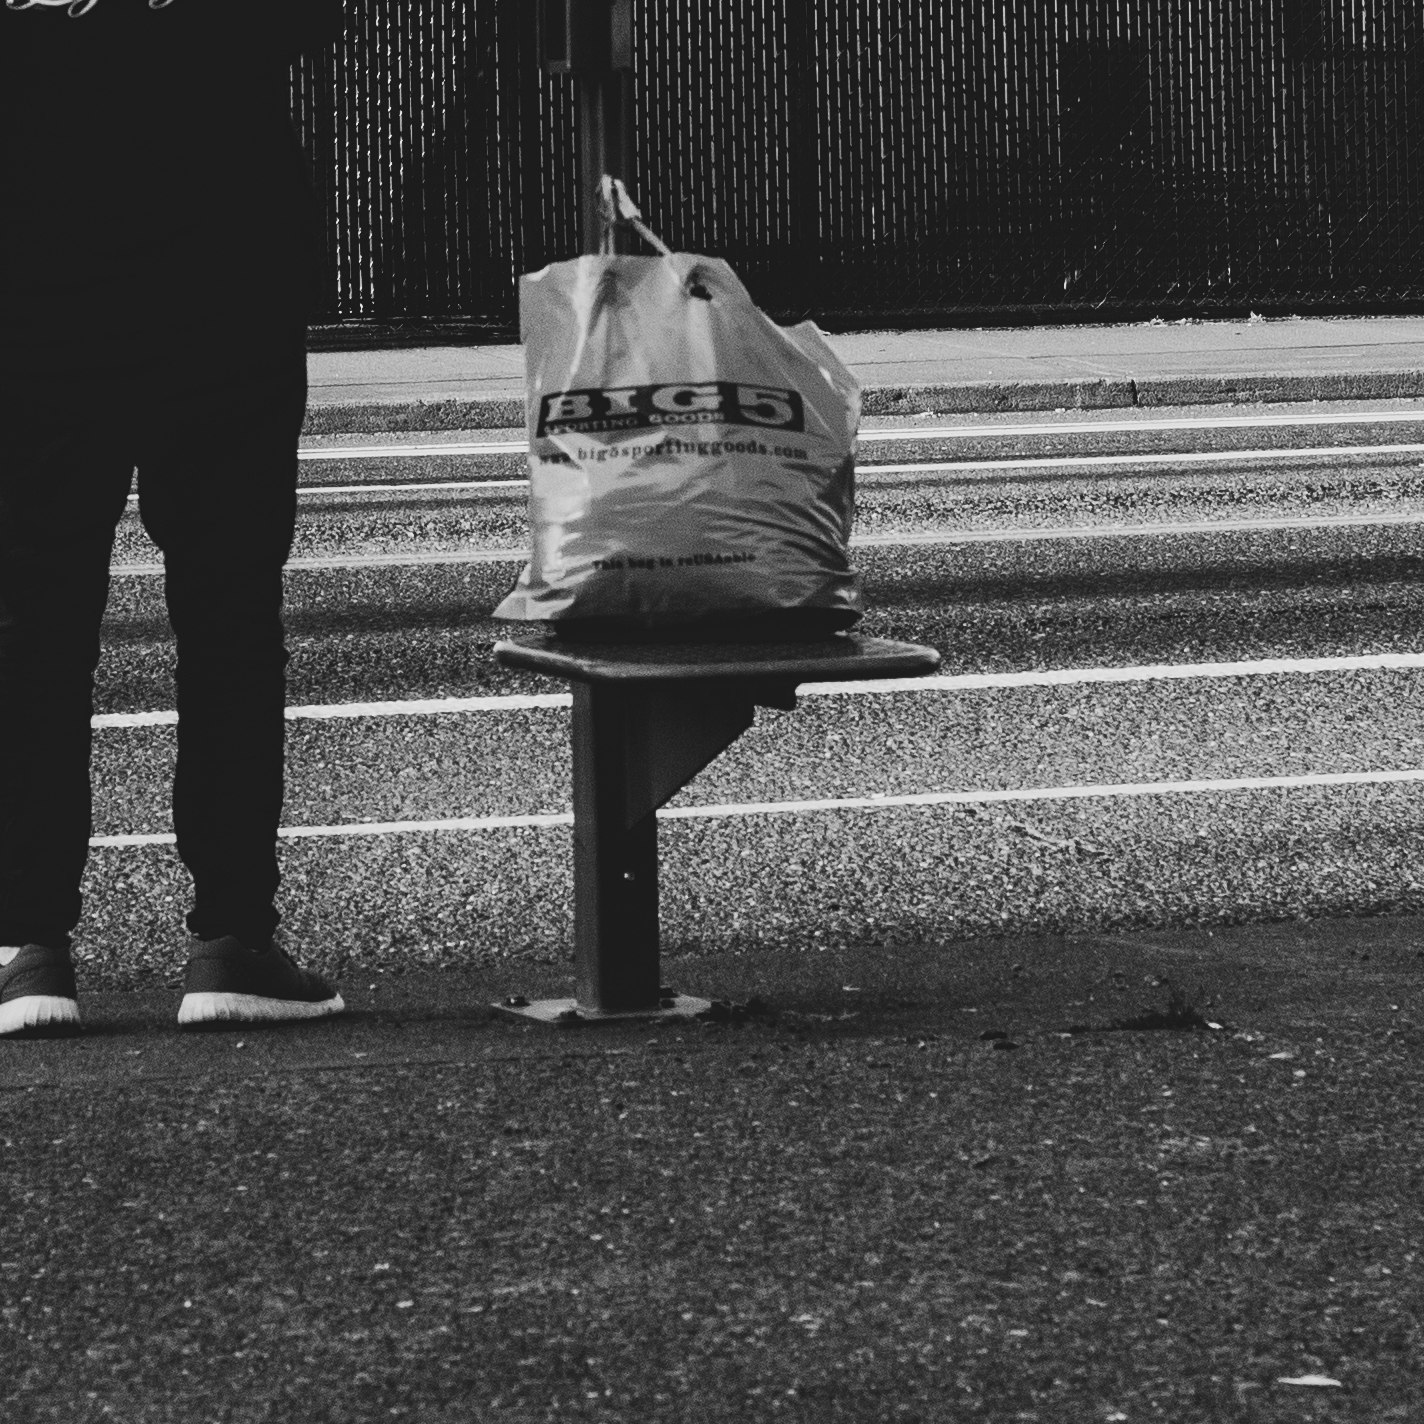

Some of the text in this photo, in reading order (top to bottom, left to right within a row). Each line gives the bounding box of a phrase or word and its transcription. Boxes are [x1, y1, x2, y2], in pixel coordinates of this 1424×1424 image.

[545, 385, 793, 425] BIG 5
[648, 412, 725, 424] GOODS
[539, 438, 808, 465] wwwbig5sportinggoods.com
